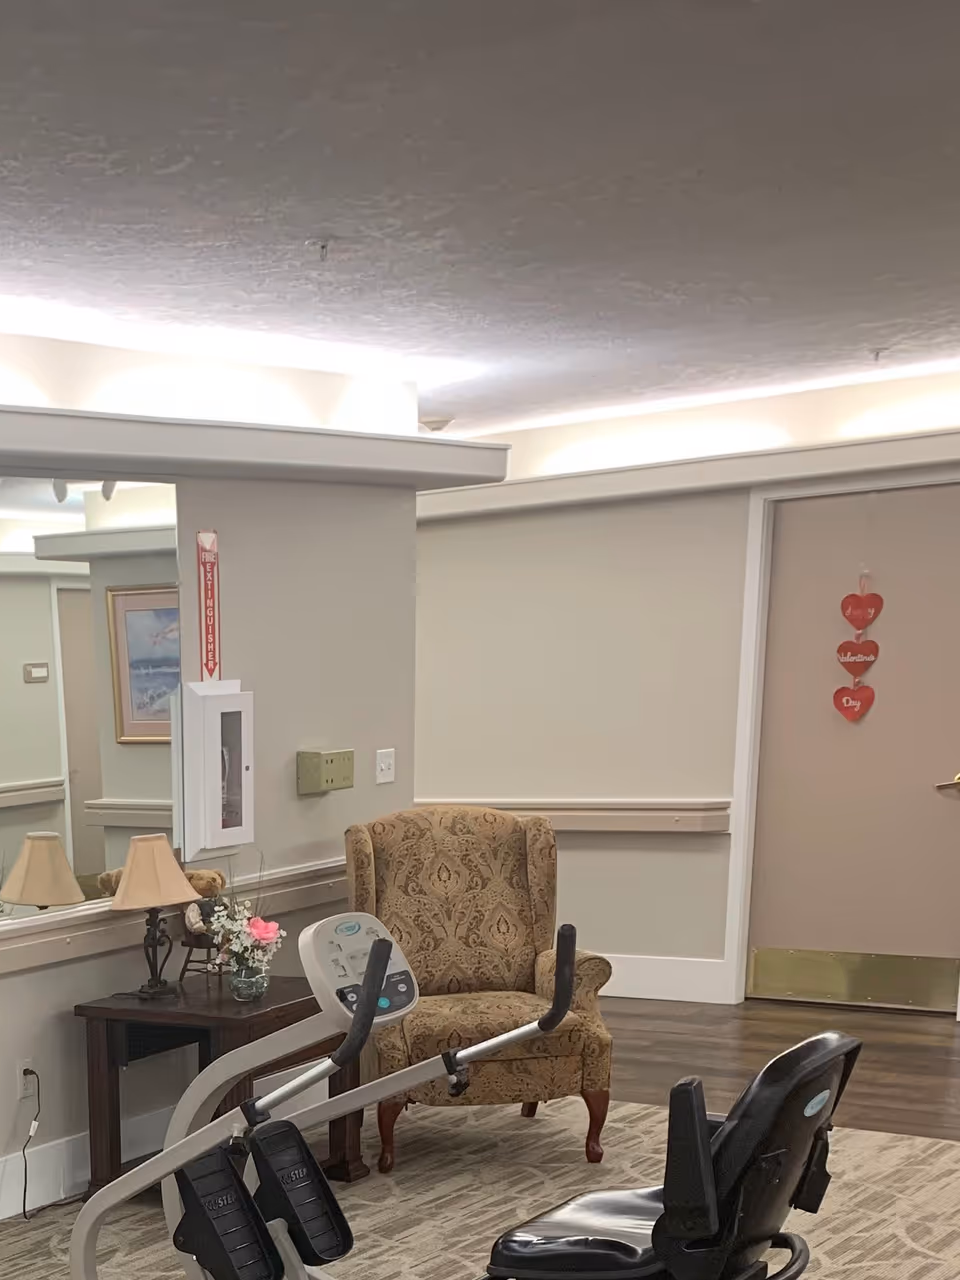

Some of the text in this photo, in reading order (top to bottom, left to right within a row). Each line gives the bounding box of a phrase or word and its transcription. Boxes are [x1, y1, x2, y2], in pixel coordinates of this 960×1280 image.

[201, 552, 216, 562] FIRE
[206, 563, 214, 669] EXTINGUISHER
[842, 697, 861, 711] Day
